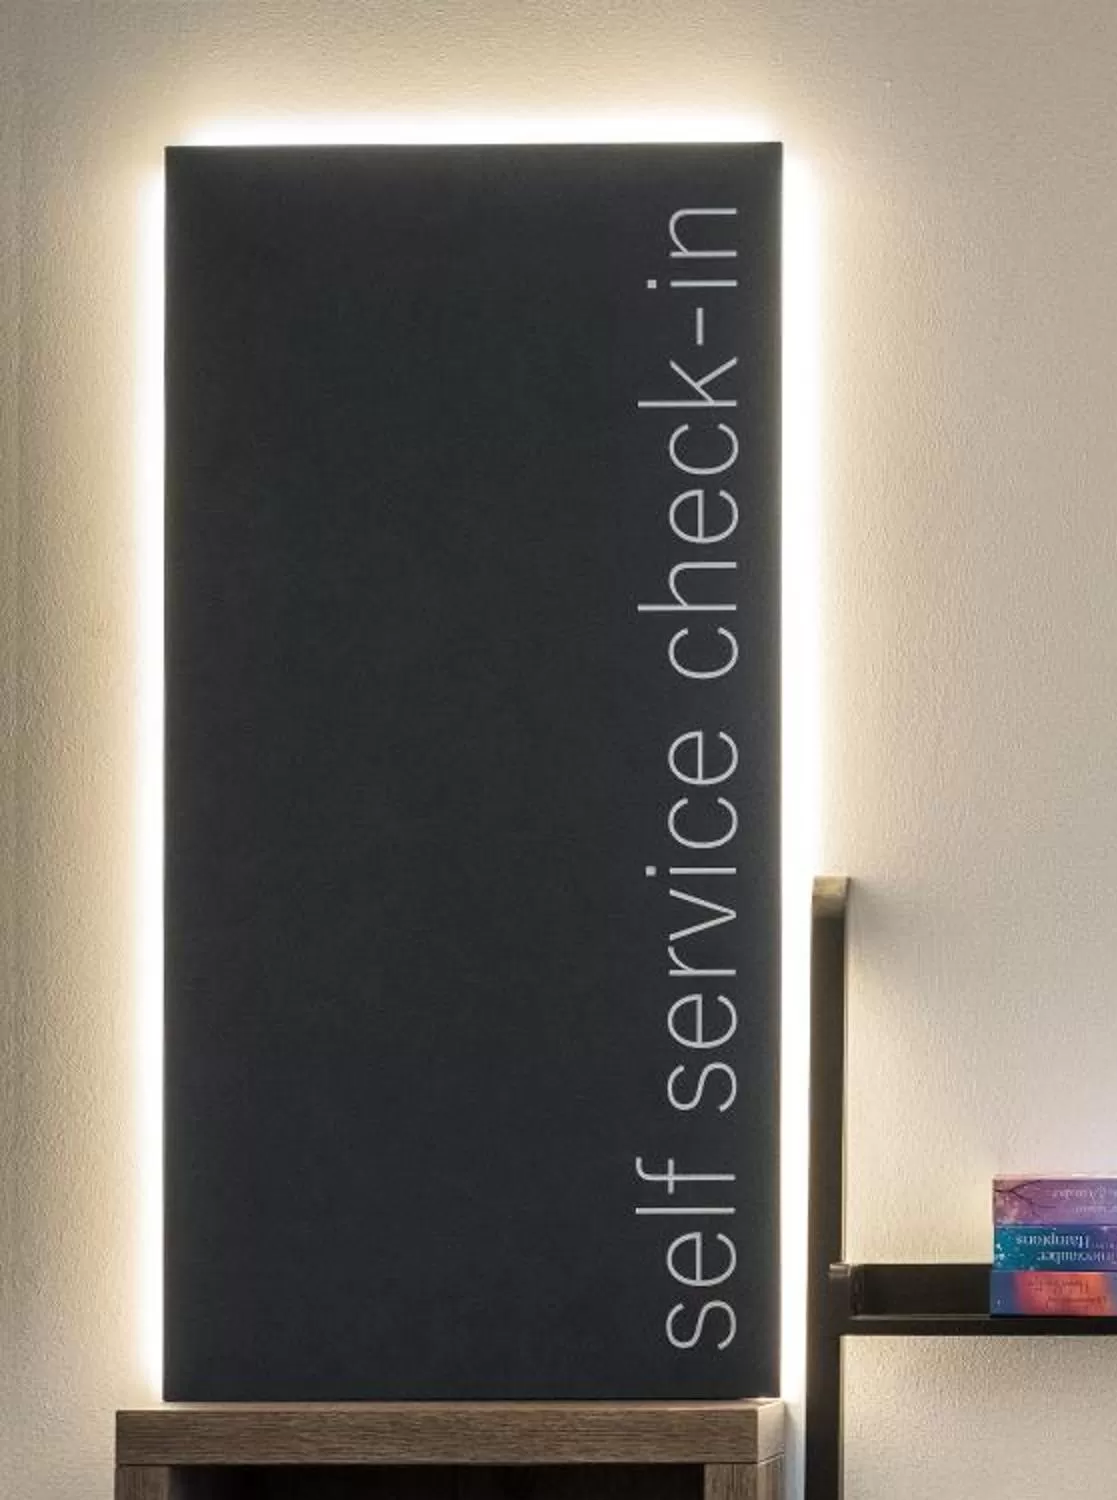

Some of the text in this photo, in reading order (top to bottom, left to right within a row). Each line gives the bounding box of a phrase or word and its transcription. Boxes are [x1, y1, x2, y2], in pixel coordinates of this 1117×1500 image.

[637, 208, 740, 1351] self service check-in
